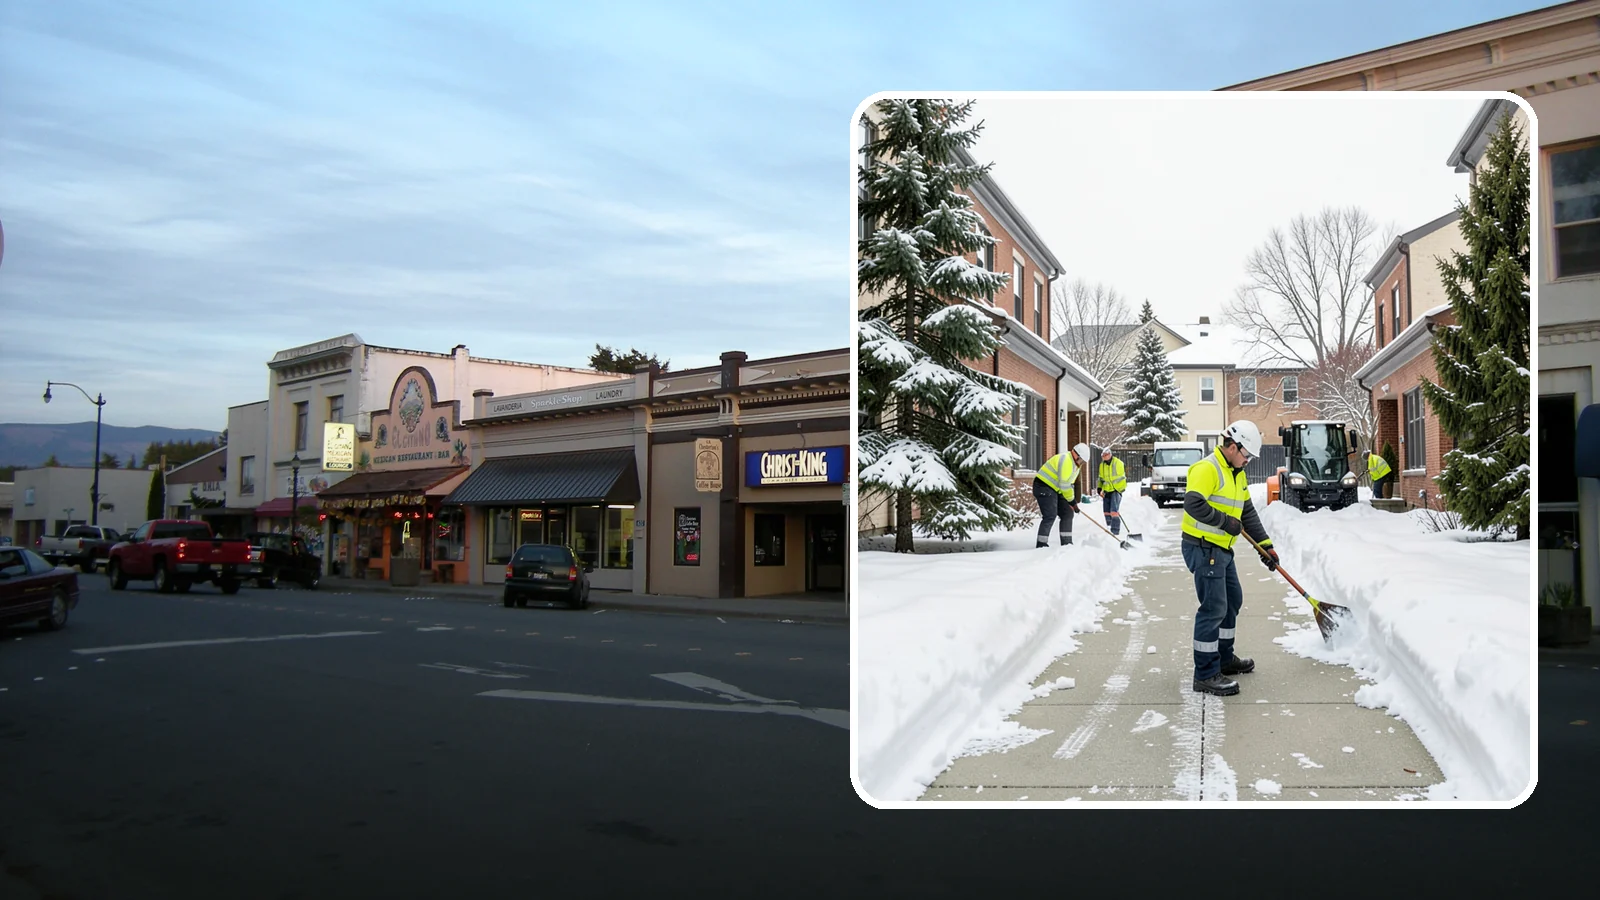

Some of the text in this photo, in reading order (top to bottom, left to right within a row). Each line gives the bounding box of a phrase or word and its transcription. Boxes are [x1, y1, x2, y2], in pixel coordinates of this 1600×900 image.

[596, 388, 623, 400] LAUNDRY
[493, 402, 522, 412] LAVANDERIA
[373, 450, 450, 464] MEXICAN RESTAURANT BAR
[760, 450, 827, 478] CHRIST KING
